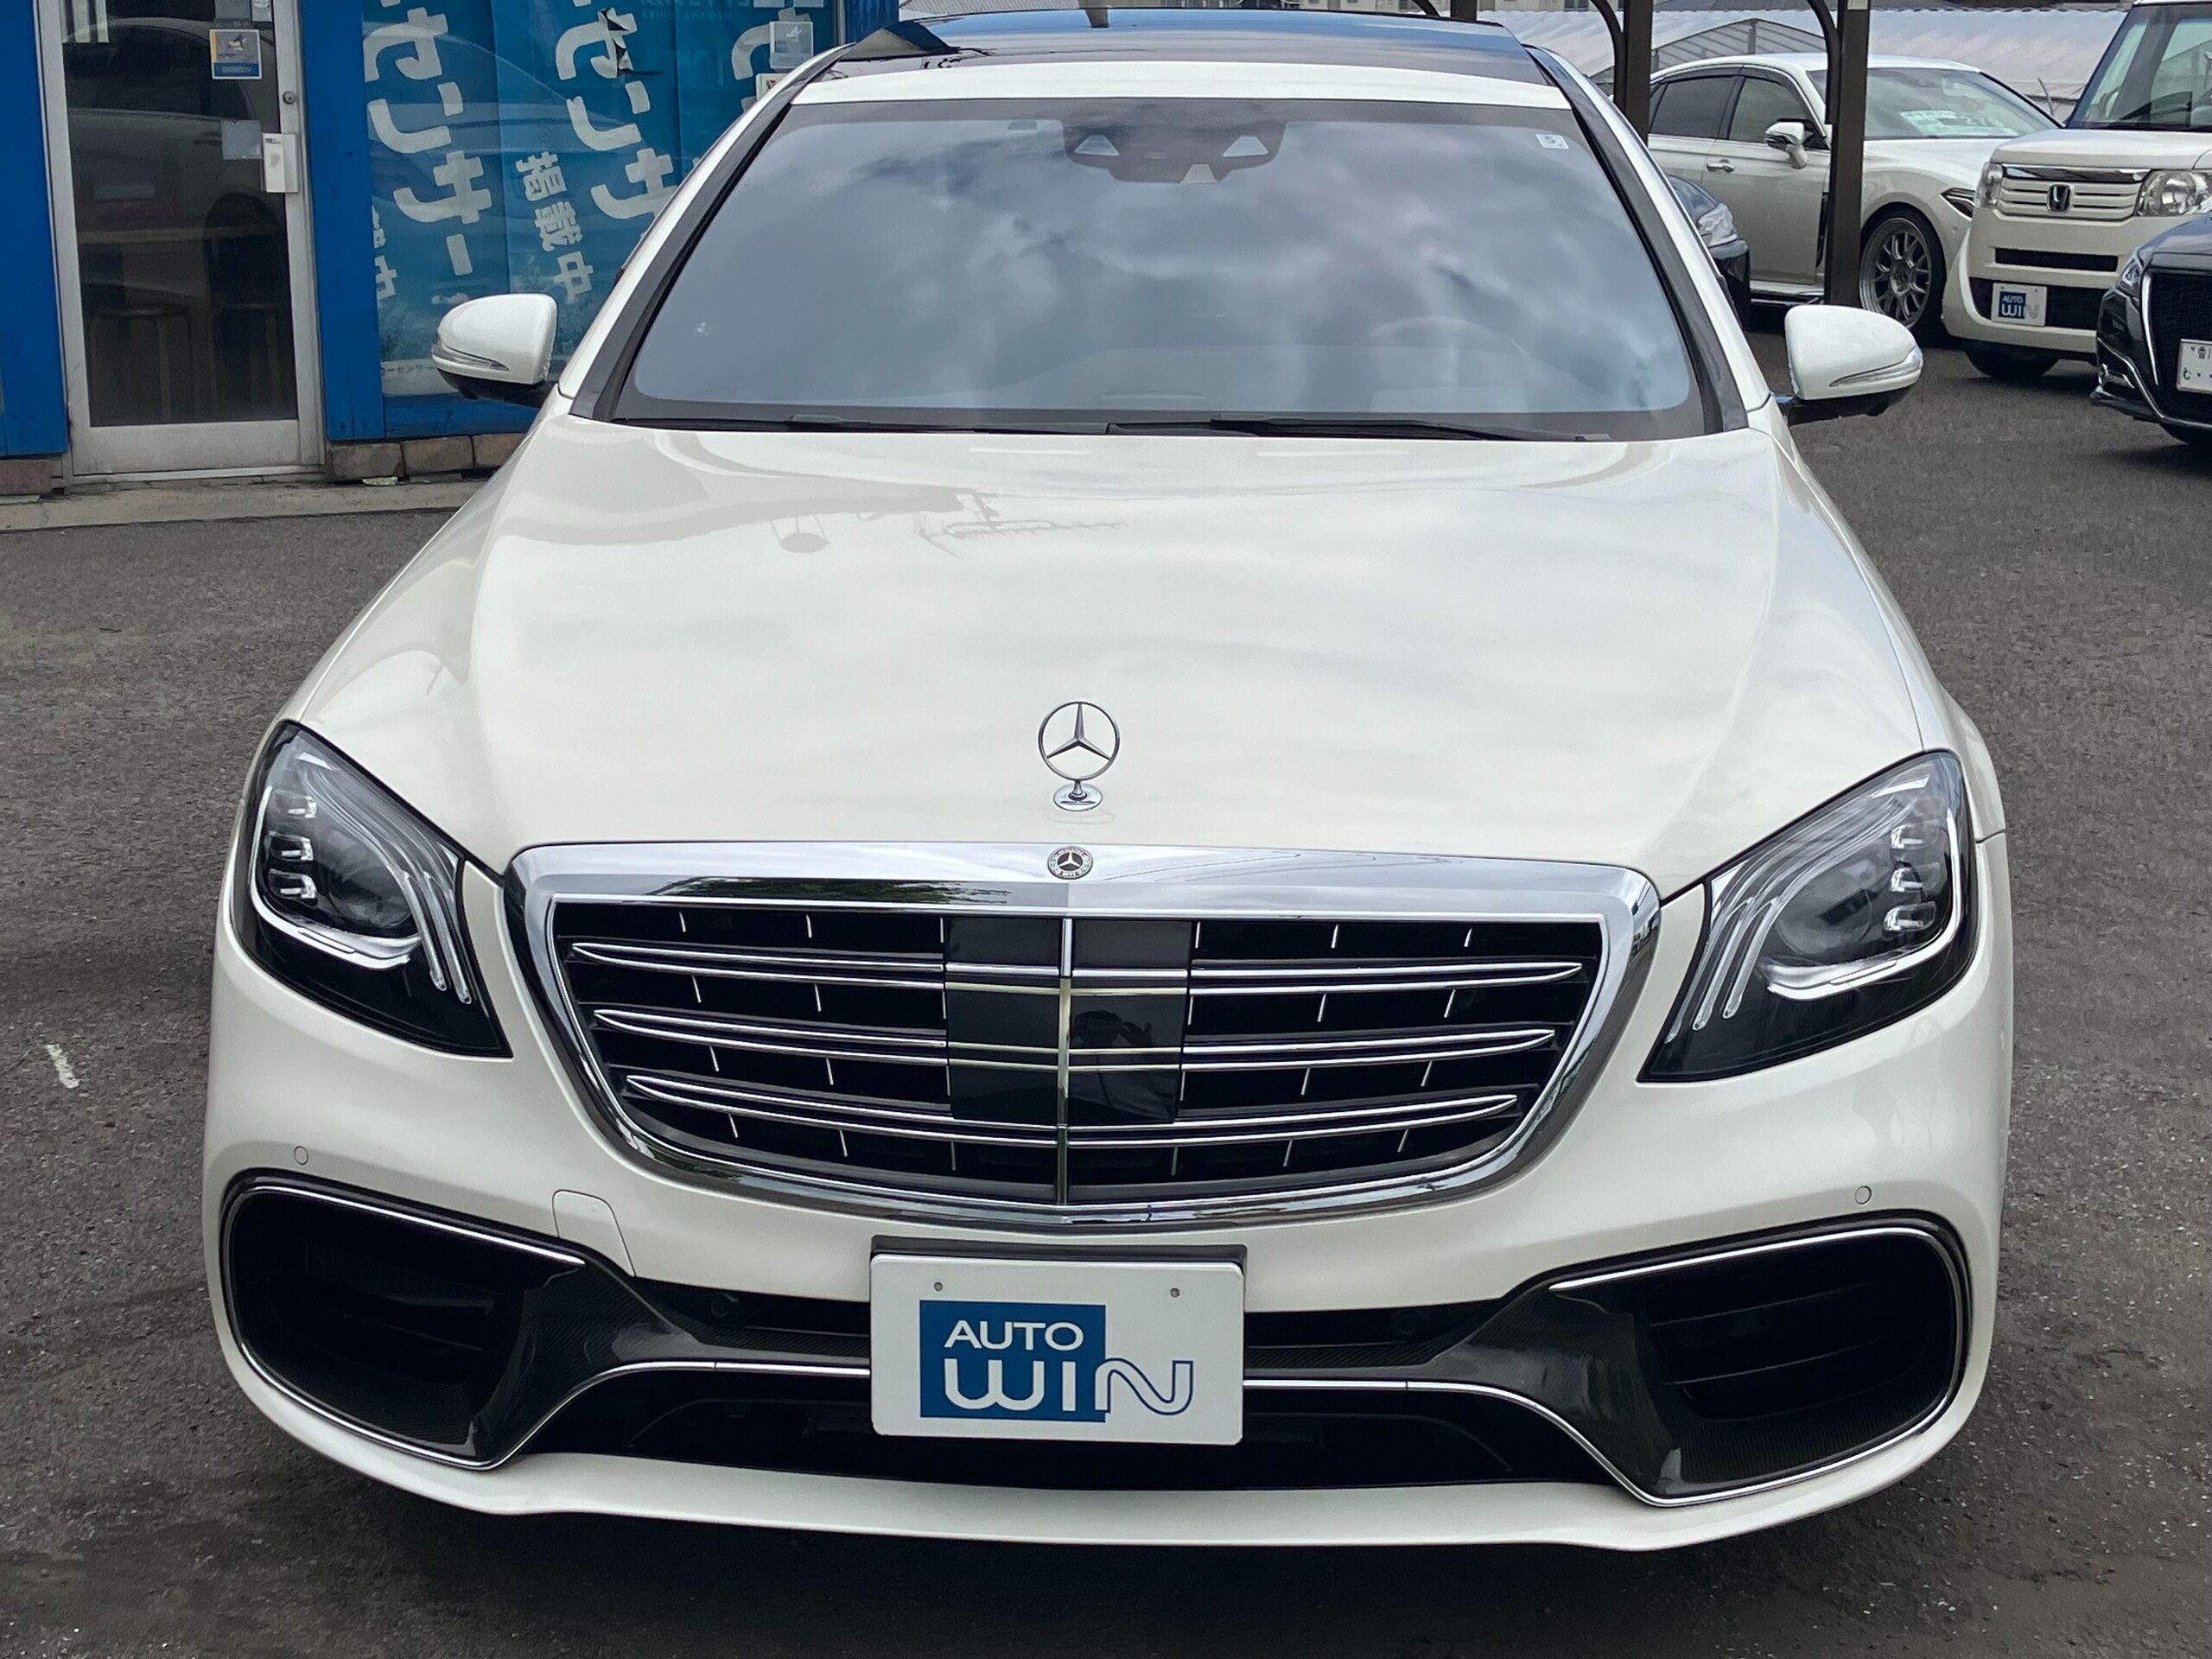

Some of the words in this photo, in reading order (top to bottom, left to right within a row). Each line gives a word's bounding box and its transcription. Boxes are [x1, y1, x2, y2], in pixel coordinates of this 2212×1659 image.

[363, 0, 493, 276] センサー
[2001, 303, 2039, 319] WIN
[2002, 295, 2024, 304] AUTO
[944, 1319, 1084, 1351] AUTO
[944, 1357, 1194, 1415] WIN
